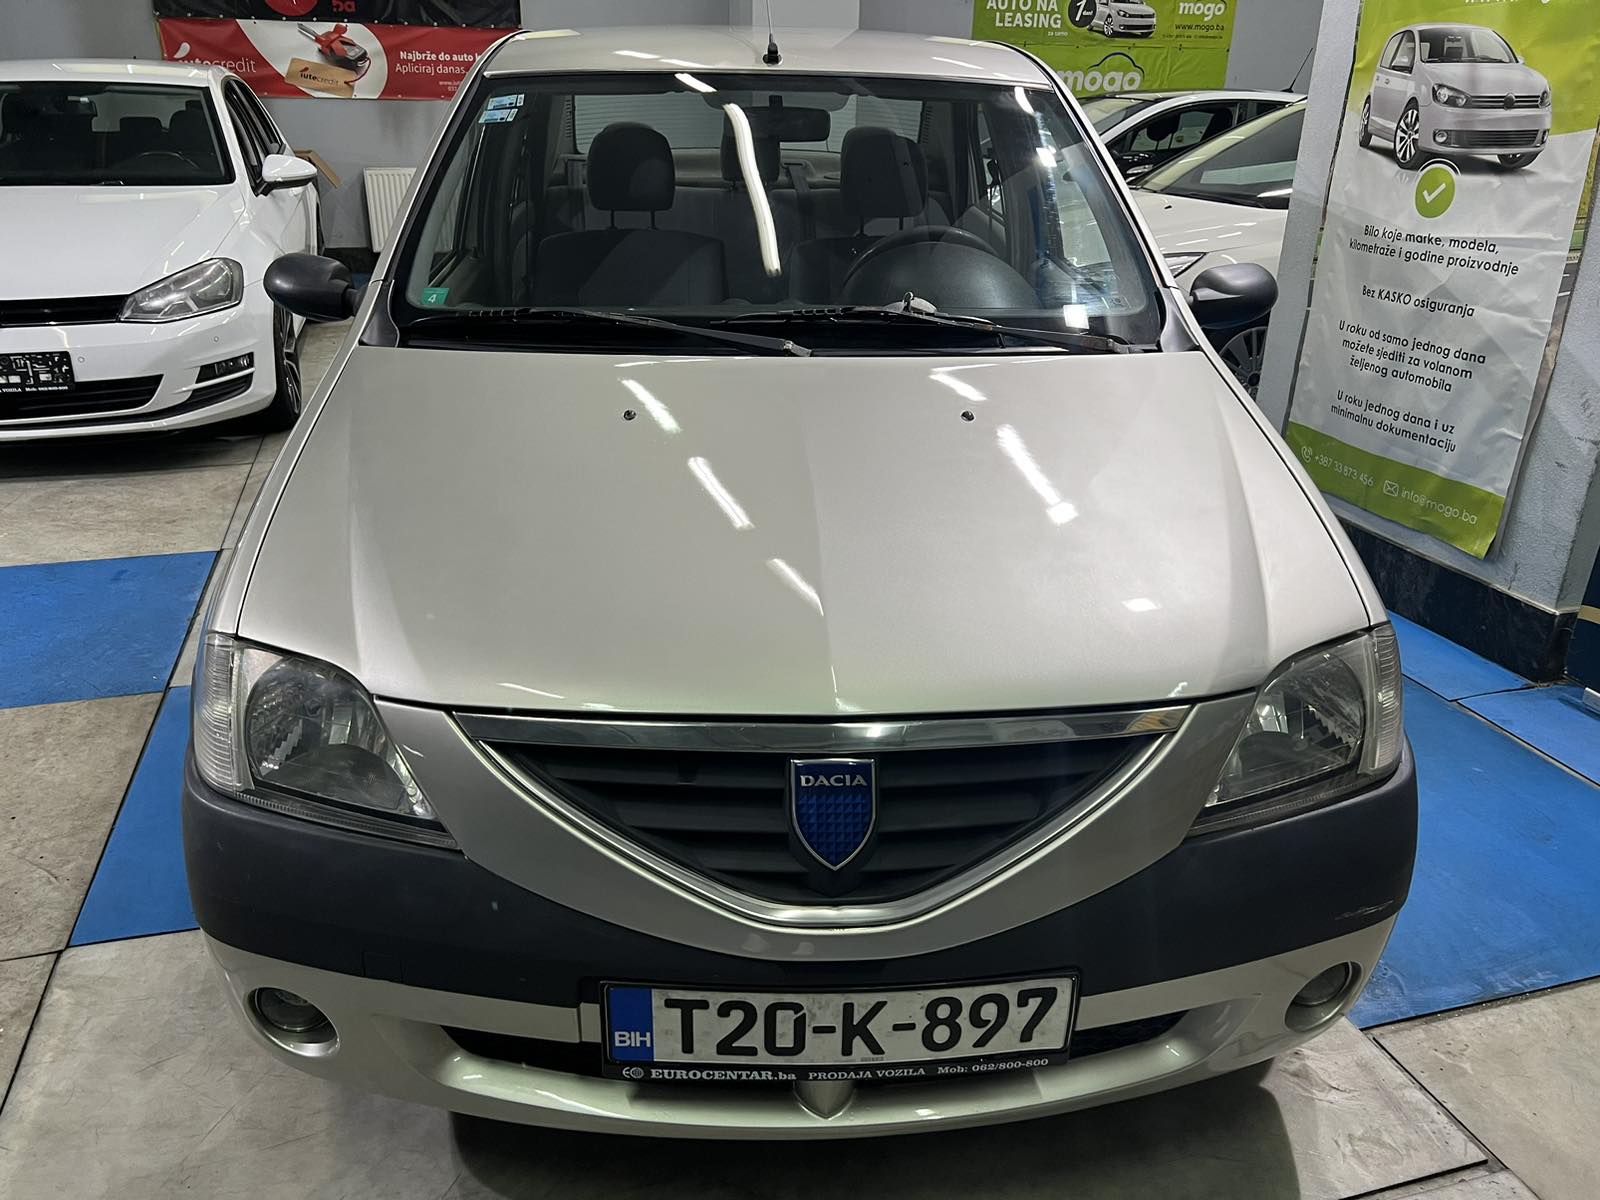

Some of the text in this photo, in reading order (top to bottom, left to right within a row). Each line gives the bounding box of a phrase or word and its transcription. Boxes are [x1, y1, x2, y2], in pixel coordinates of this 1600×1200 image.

[995, 12, 1061, 28] LEASING
[1179, 2, 1225, 21] mogo
[1175, 23, 1225, 32] www.mogo.ba
[395, 63, 435, 76] Apliciraj
[400, 51, 436, 62] Najbrže
[438, 52, 451, 61] do
[452, 53, 474, 62] auto
[1364, 224, 1500, 254] Bilo koje marke, modela,
[1349, 238, 1519, 277] kilometraže i godine proizvodnje
[428, 294, 437, 303] 4
[1362, 284, 1475, 319] Bez KASKO osiguranja
[1339, 319, 1486, 364] U roku od samo jednog dana
[1342, 337, 1473, 379] možete sjediti za volanom
[1349, 355, 1453, 392] željenog automobila
[1337, 389, 1456, 435] U roku jednog dana i uz
[1331, 404, 1457, 453] minimalnu dokumentaciju
[1314, 455, 1374, 487] +387 33 873 456
[1401, 487, 1478, 525] info@mogo.ba
[800, 774, 868, 787] DACIA
[663, 986, 1059, 1057] T20-K-897
[614, 1031, 652, 1048] BIH
[650, 1068, 797, 1081] EUROCENTAR.ba
[807, 1070, 873, 1080] PRODAJA
[875, 1067, 926, 1078] VOZILA
[937, 1065, 969, 1075] Mob:
[971, 1057, 1049, 1073] 062/800-800
